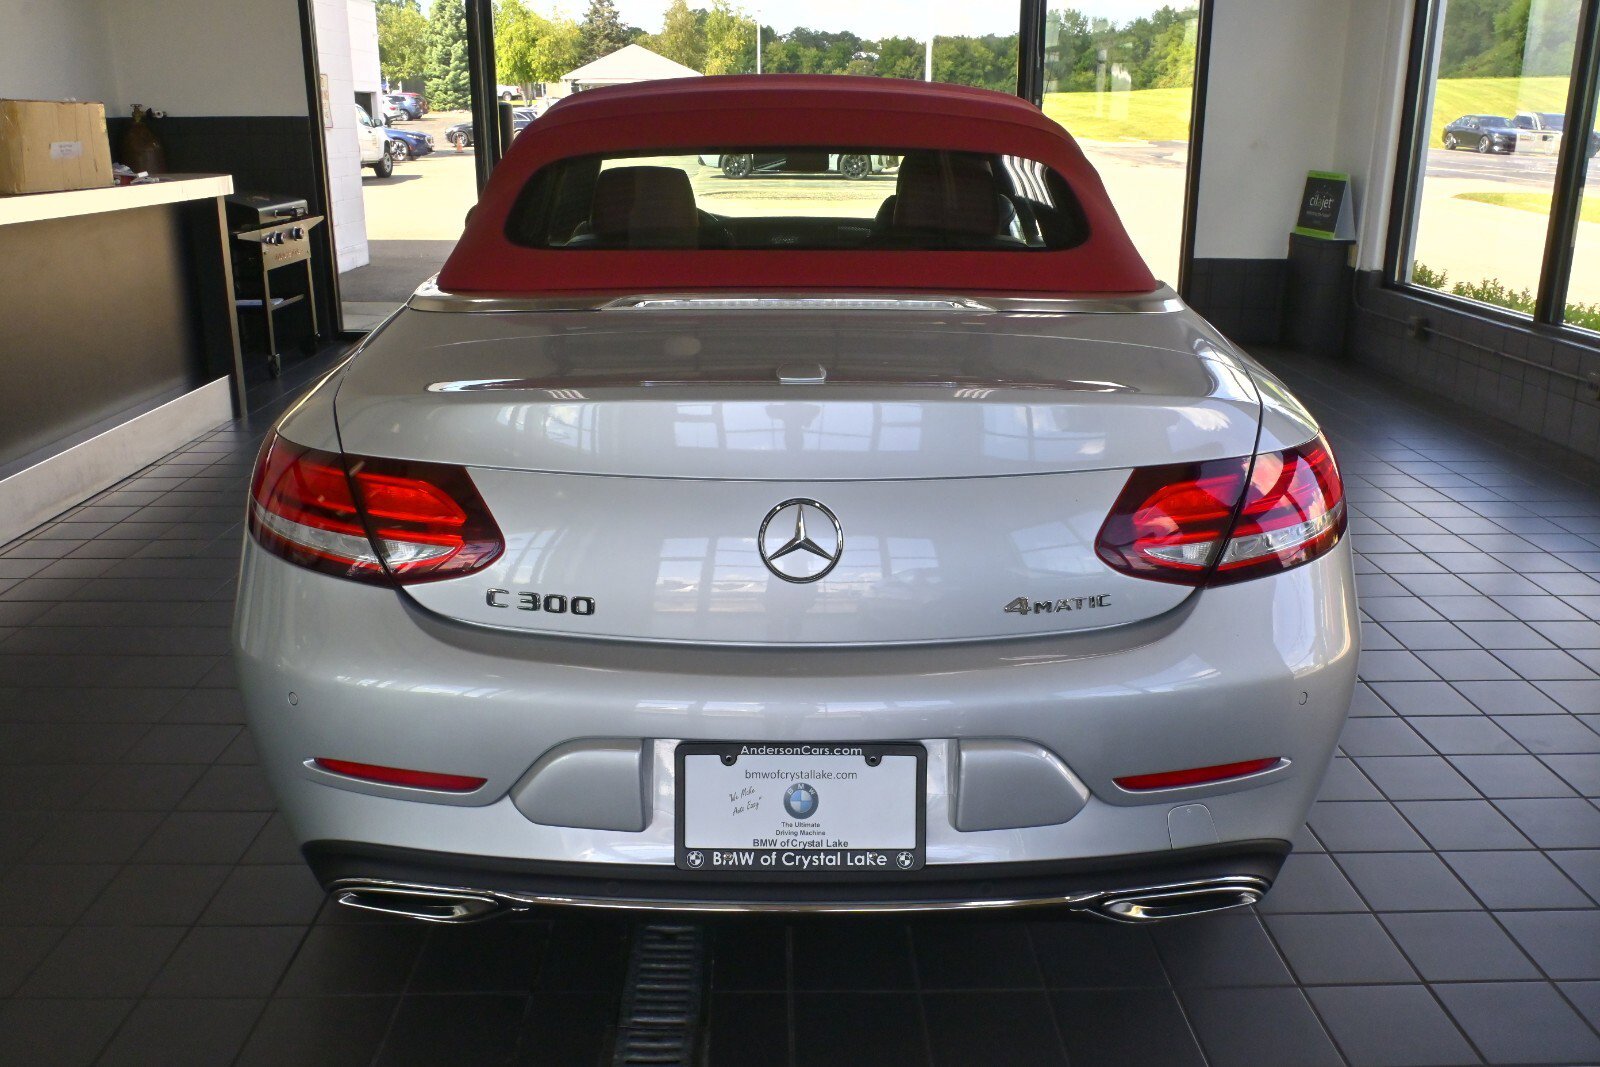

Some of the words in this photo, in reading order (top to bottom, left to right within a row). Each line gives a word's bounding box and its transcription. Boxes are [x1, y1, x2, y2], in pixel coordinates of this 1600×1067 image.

[486, 588, 509, 608] C
[517, 592, 596, 616] 300
[1004, 594, 1112, 615] 4MATIC
[740, 745, 862, 756] AndersonCars.com
[745, 770, 858, 780] bmwofcrystallake.com
[753, 839, 777, 847] BMW
[780, 839, 790, 847] of
[791, 839, 823, 849] Crystal
[826, 839, 849, 847] Lake
[713, 852, 755, 866] BMW
[760, 852, 777, 866] of
[781, 852, 841, 869] Crystal
[847, 852, 888, 866] Lake
